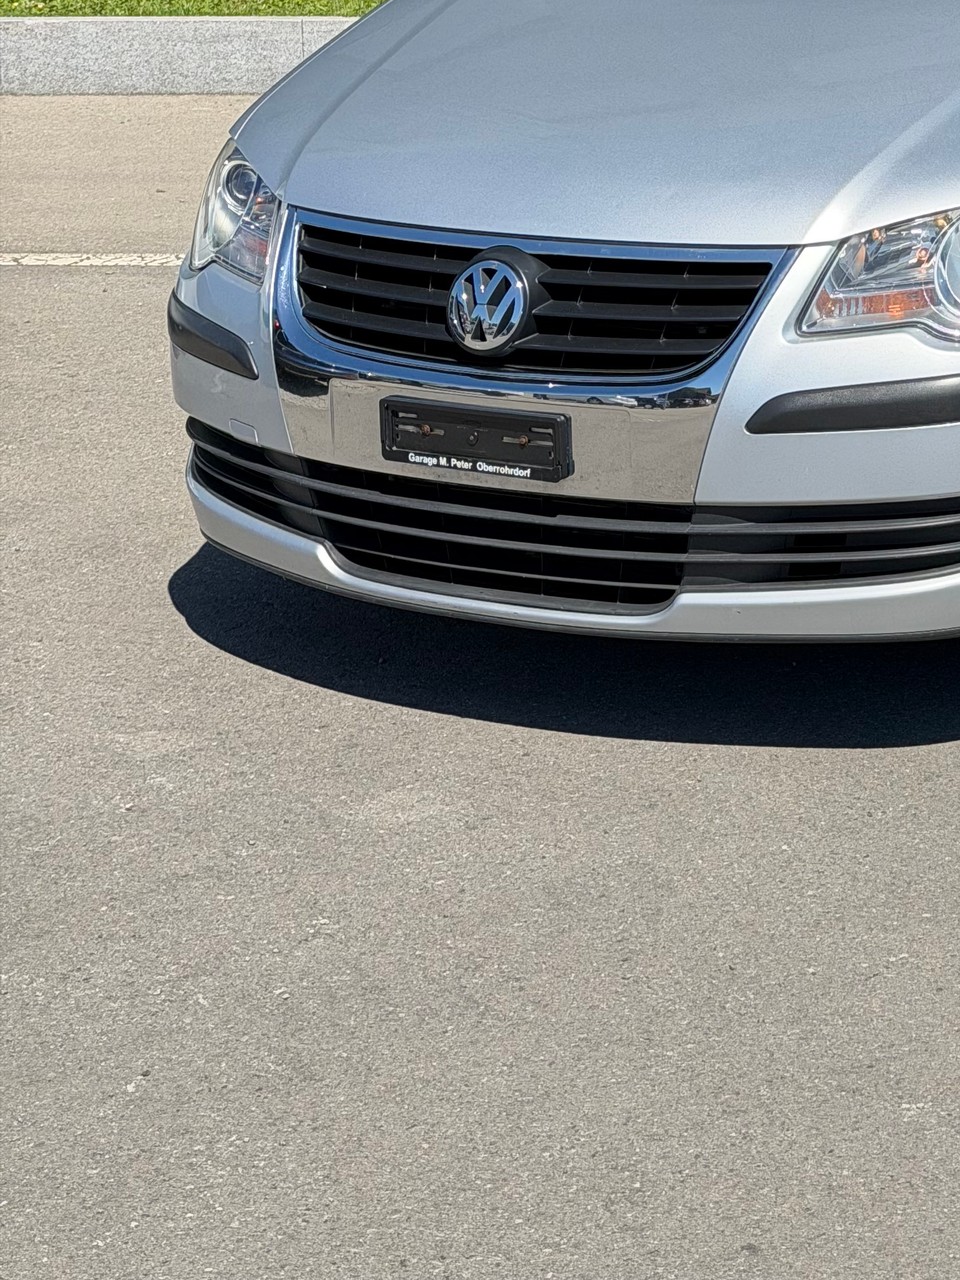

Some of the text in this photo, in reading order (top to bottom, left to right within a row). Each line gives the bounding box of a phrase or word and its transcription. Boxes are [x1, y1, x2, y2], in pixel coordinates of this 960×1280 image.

[448, 260, 524, 351] VW
[408, 452, 531, 478] Garage M. Peter Oberrohrdorf
